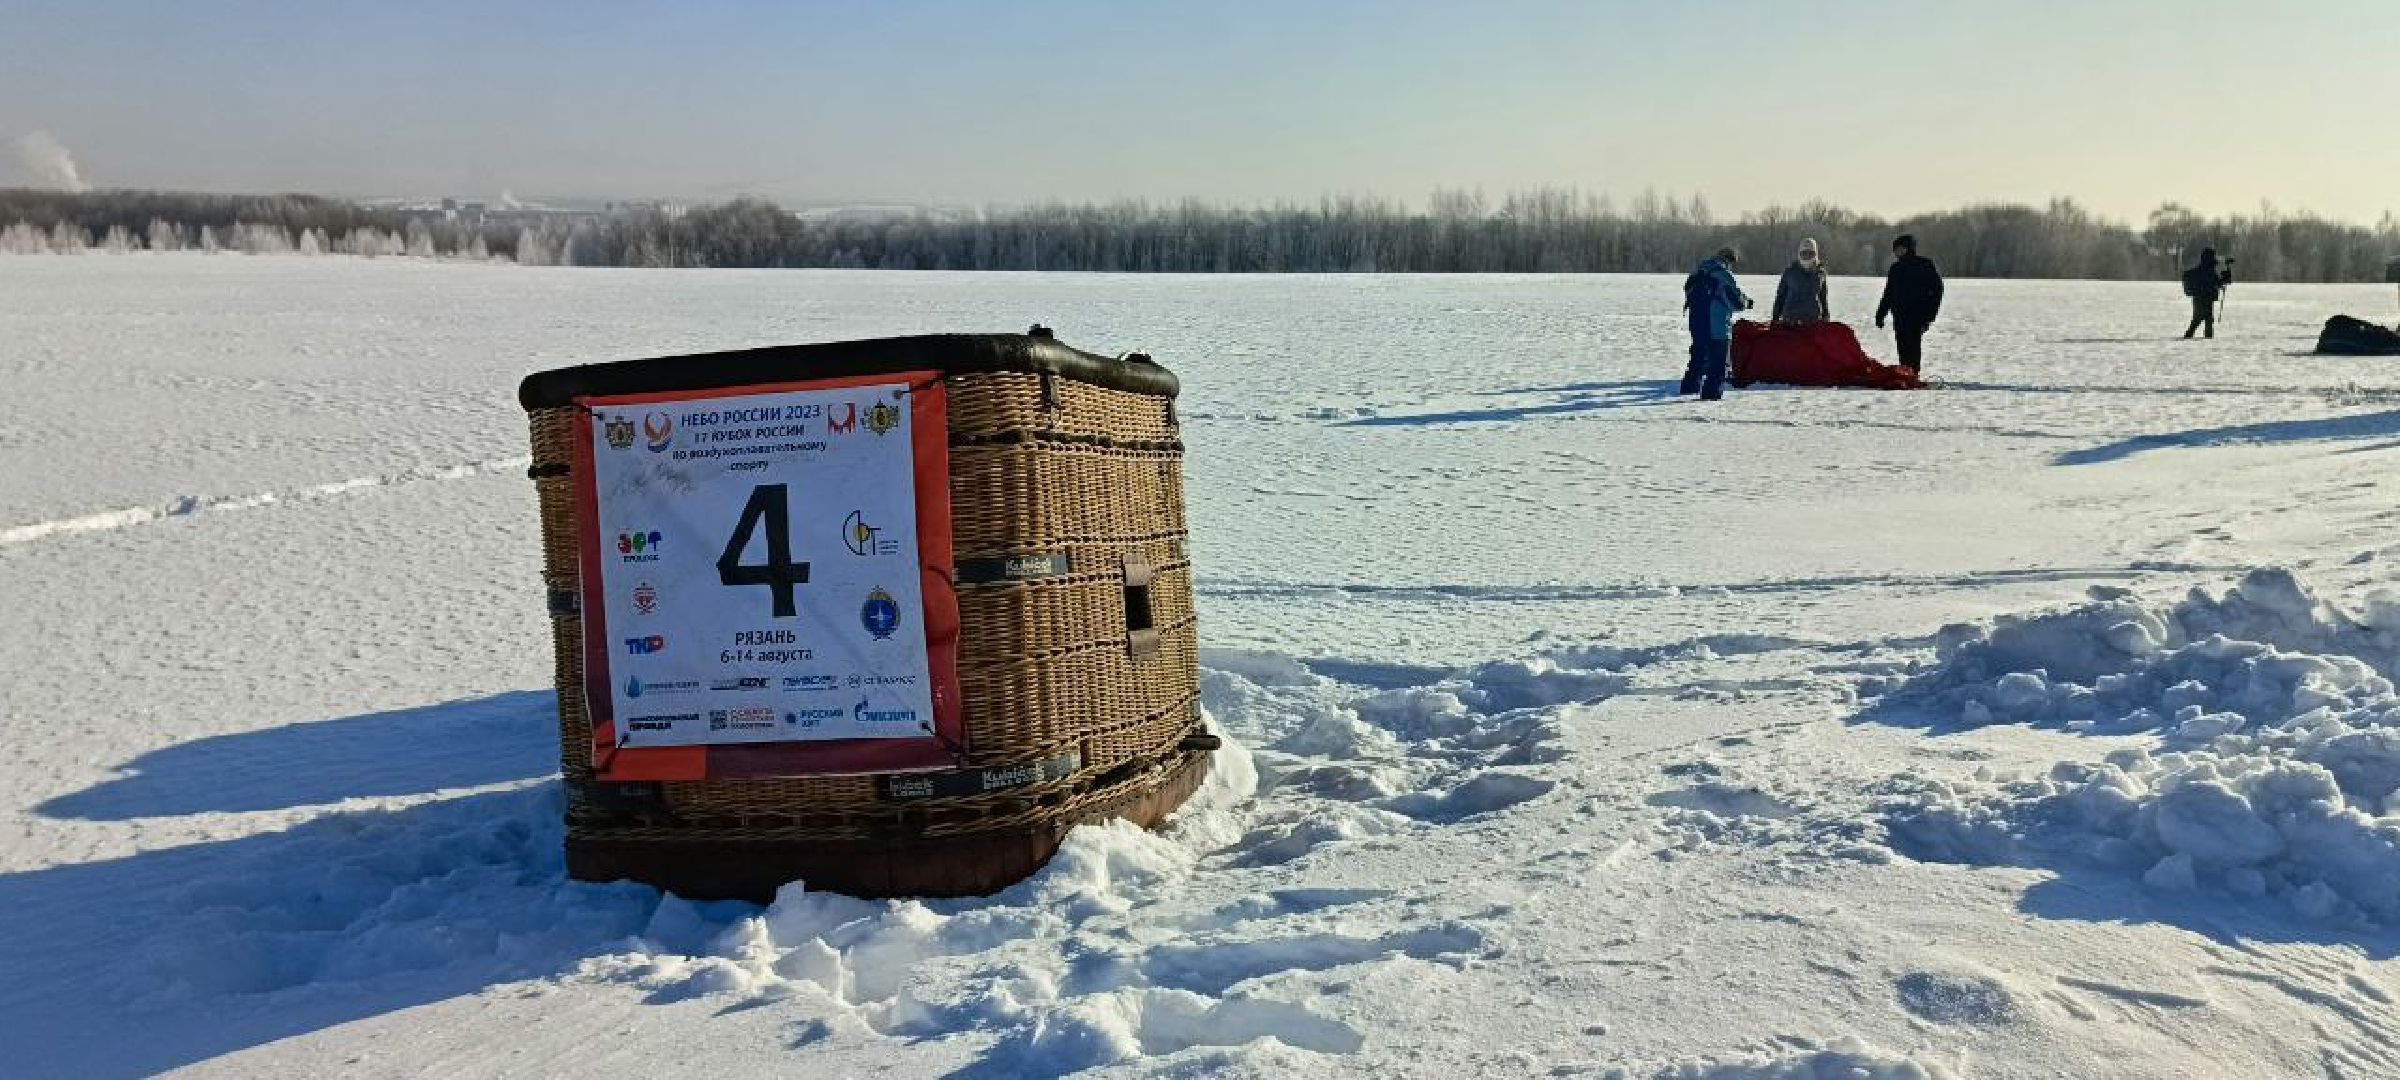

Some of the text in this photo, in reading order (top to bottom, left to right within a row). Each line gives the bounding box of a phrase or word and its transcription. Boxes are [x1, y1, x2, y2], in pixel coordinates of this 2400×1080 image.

[681, 404, 821, 428] НЕБО РОССИИ 2023
[694, 424, 805, 444] 17 КУБОК РОССИИ
[672, 450, 687, 460] по
[730, 459, 769, 472] спорту
[716, 483, 810, 617] 4
[735, 630, 796, 646] РЯЗАНЬ
[720, 649, 812, 664] 6-14 августа
